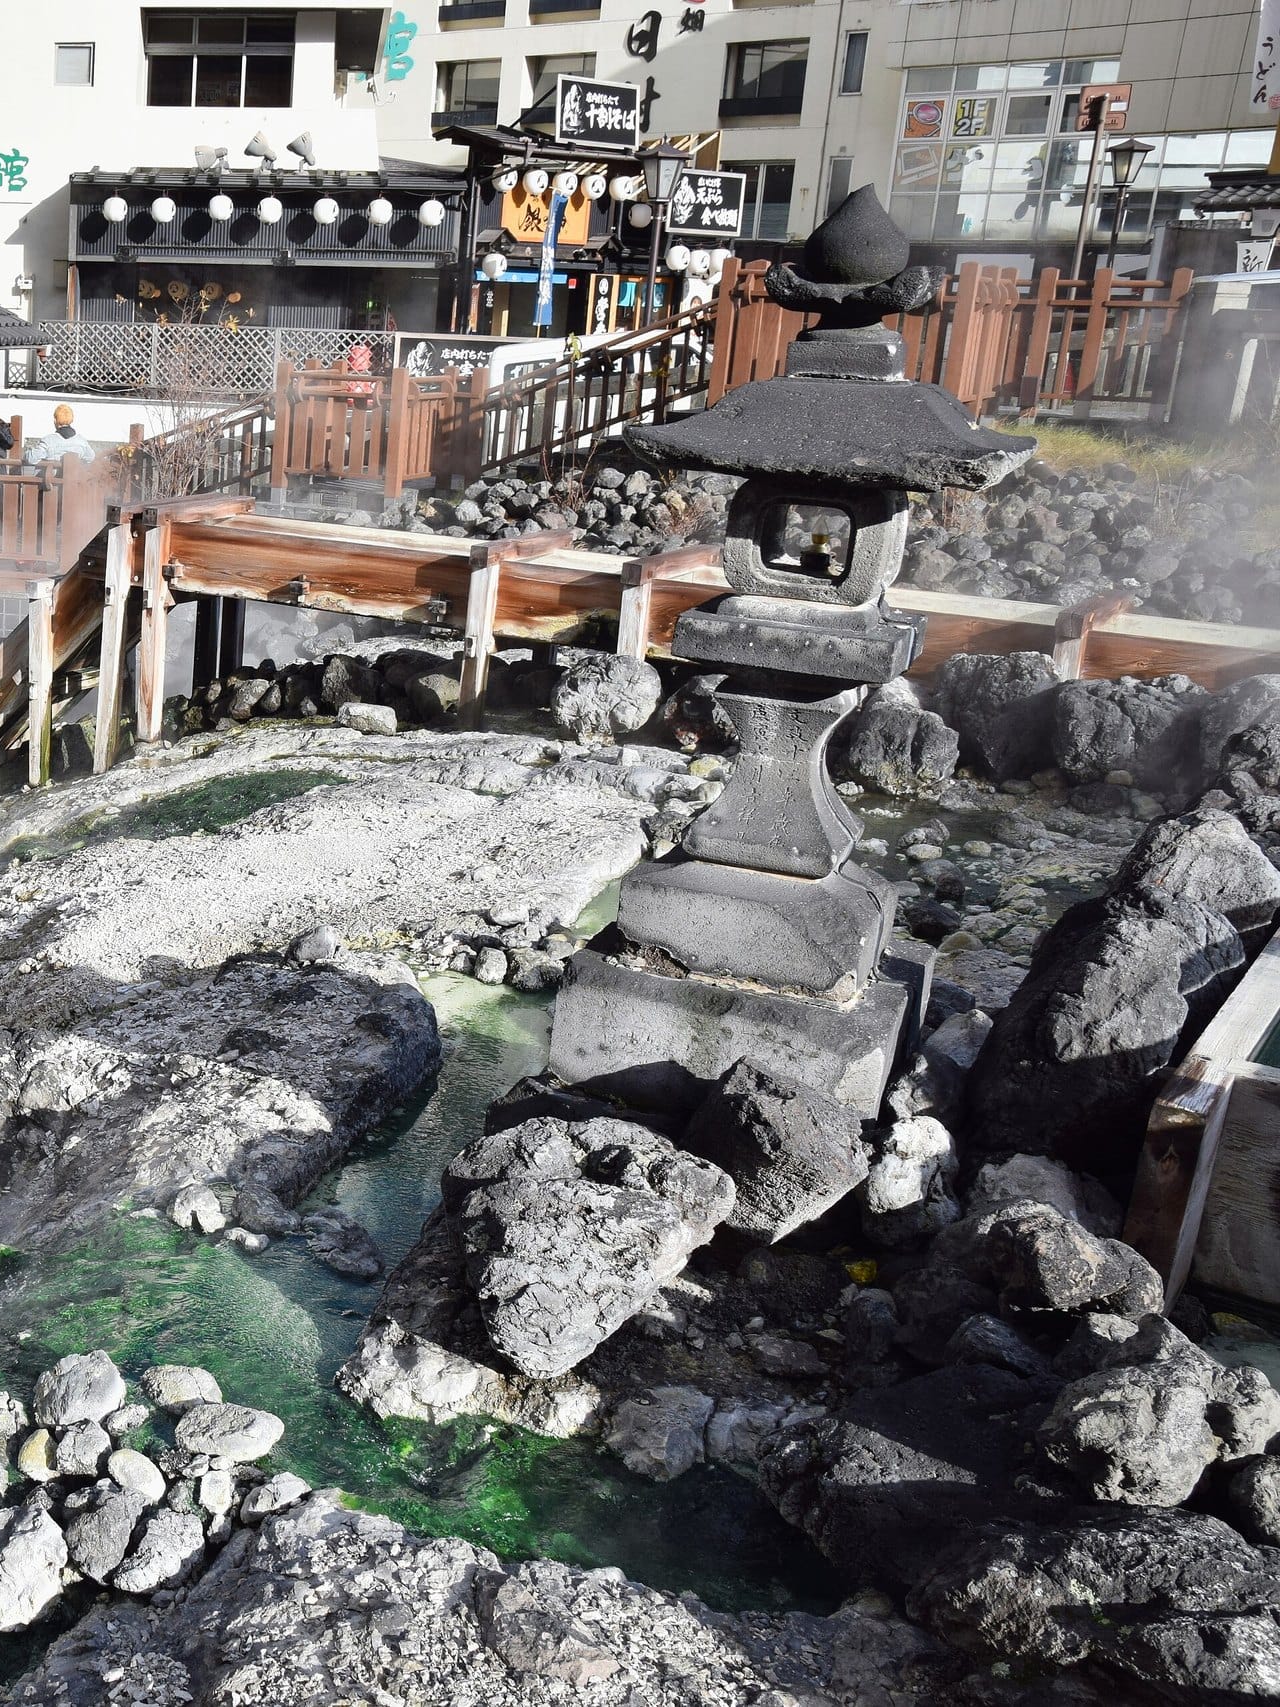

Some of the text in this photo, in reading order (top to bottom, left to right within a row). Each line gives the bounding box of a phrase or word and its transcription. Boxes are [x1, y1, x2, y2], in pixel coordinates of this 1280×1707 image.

[1253, 36, 1276, 104] うどん
[960, 99, 987, 118] 1F
[955, 118, 984, 136] 2F
[695, 187, 724, 206] 天ぷら
